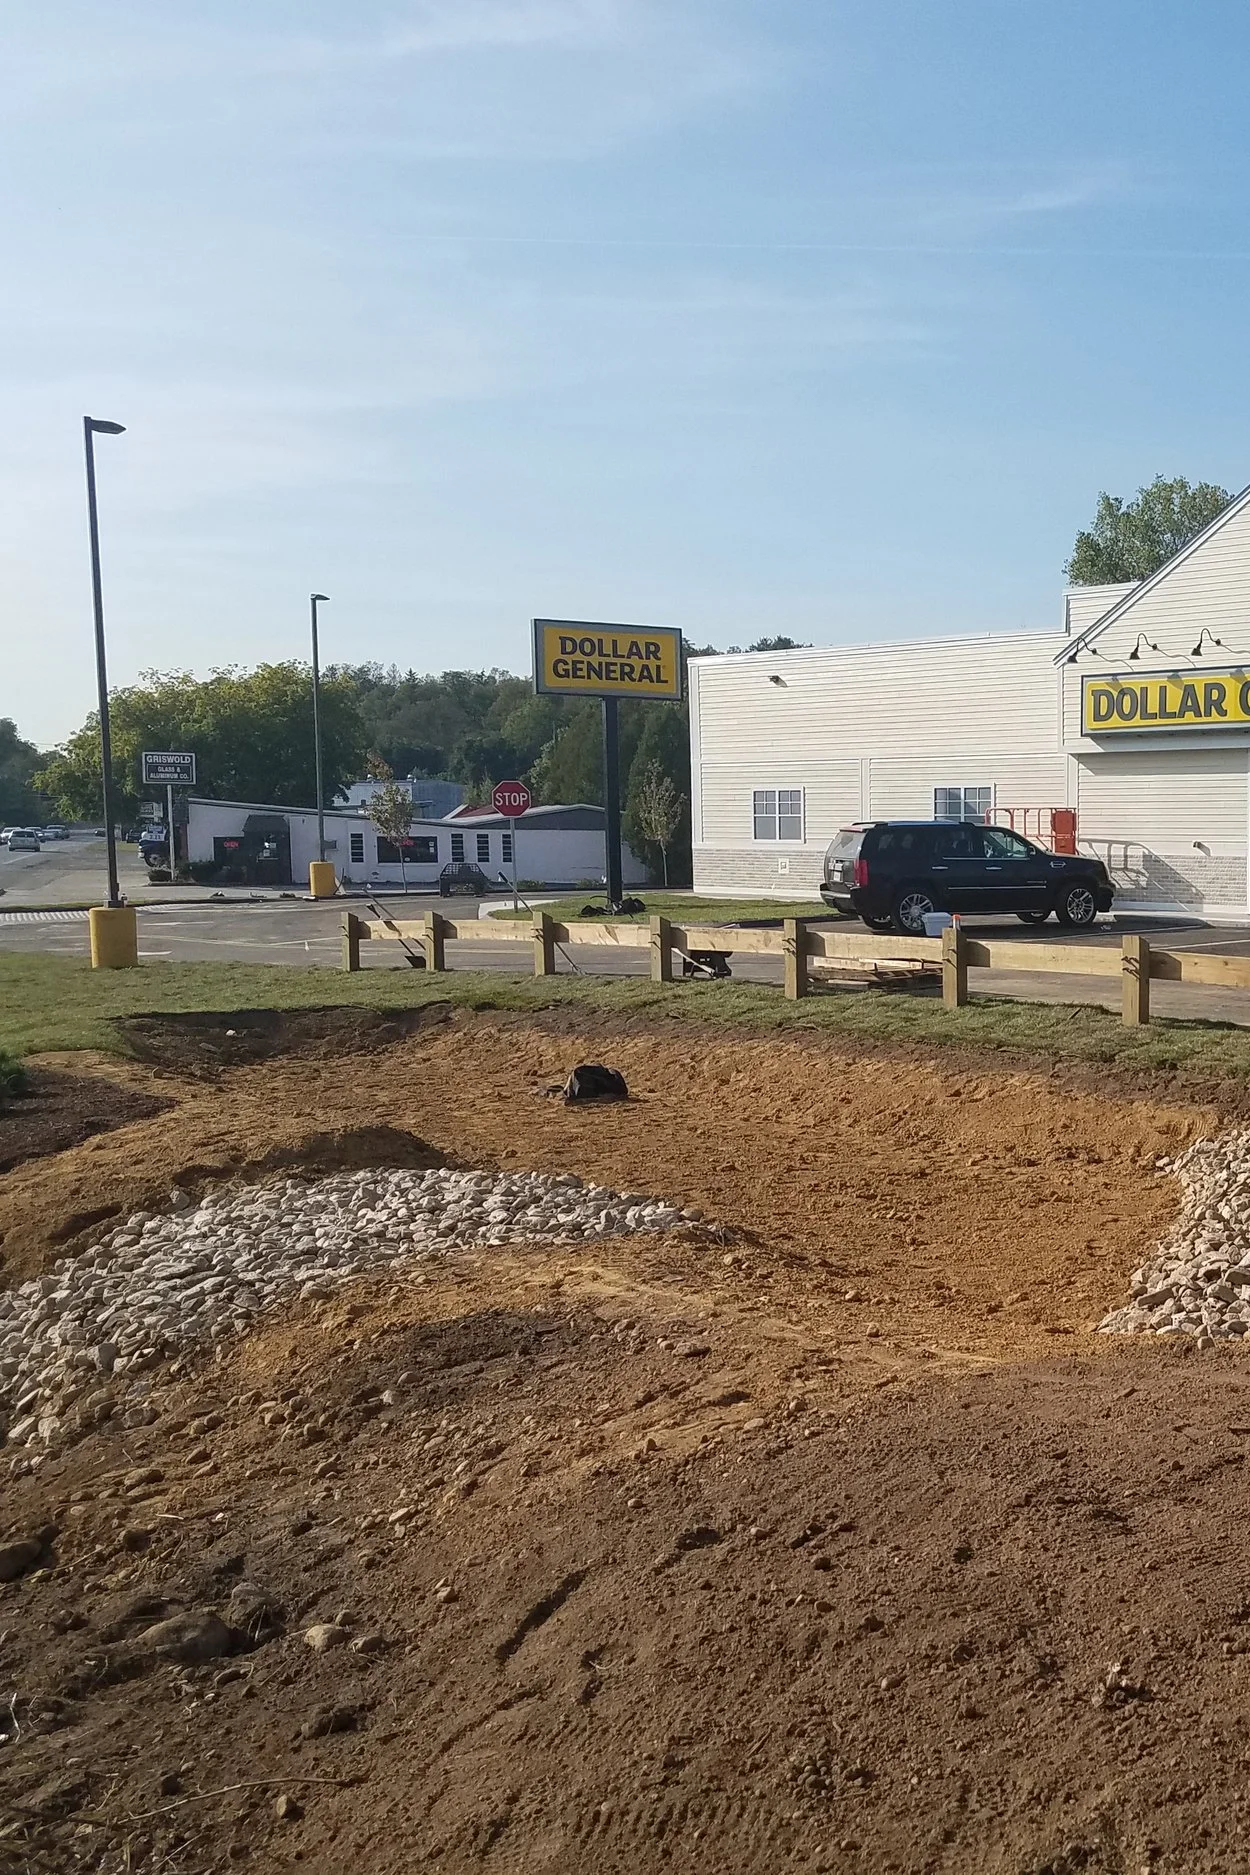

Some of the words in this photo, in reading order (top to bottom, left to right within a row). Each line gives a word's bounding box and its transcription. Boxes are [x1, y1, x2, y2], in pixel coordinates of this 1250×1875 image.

[559, 635, 662, 661] DOLLAR
[552, 658, 669, 684] GENERAL
[1092, 682, 1227, 722] DOLLAR
[146, 755, 191, 763] GRISWOLD
[494, 792, 528, 806] STOP
